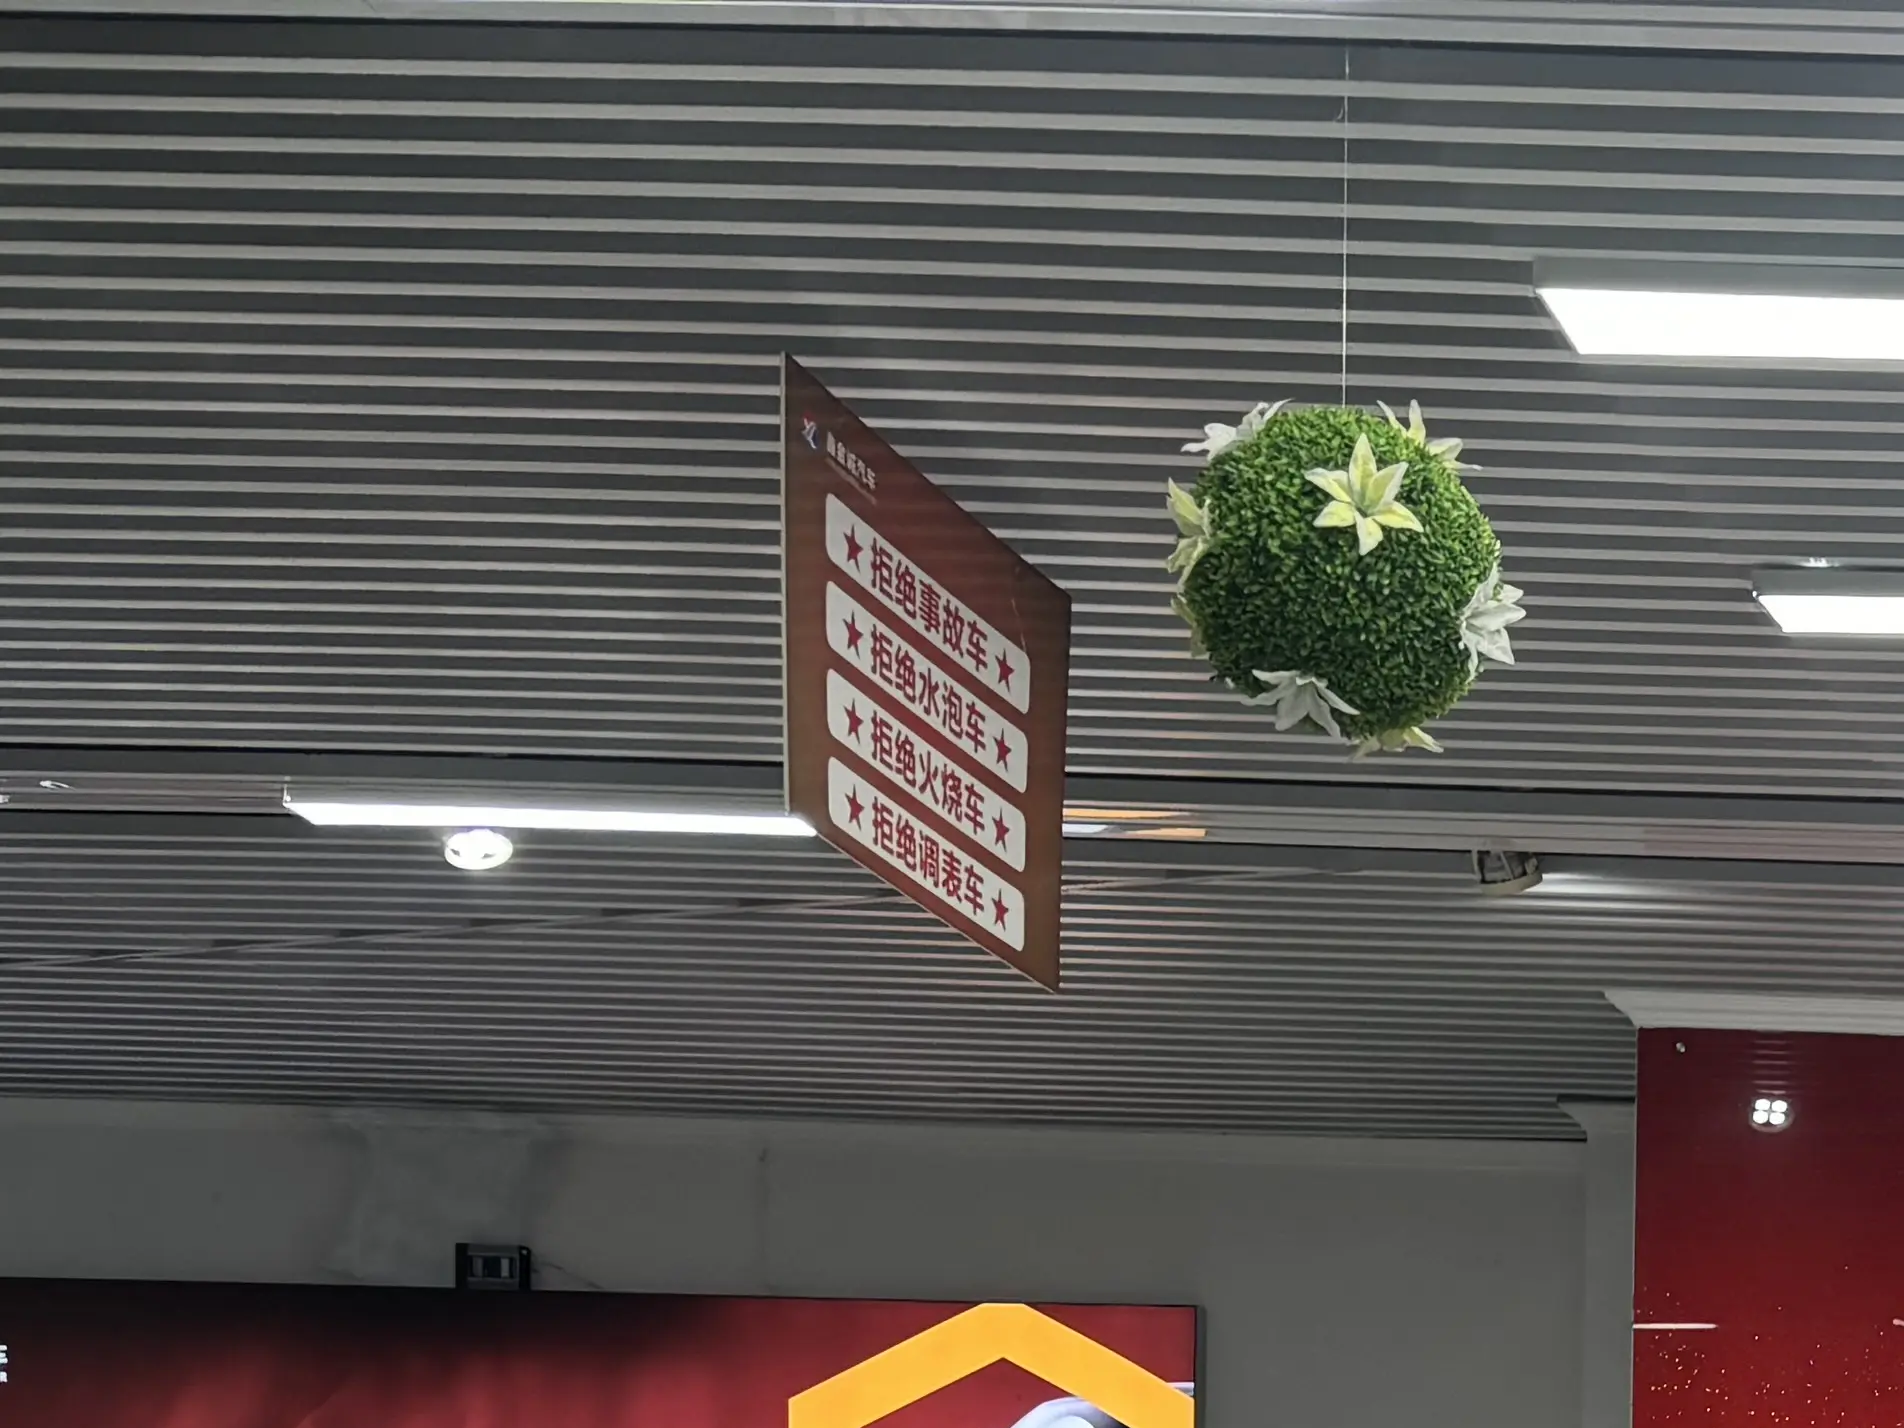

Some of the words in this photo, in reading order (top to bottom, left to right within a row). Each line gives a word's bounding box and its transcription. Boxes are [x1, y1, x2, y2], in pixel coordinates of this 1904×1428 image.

[871, 538, 987, 671] 拒绝事故车
[871, 624, 986, 754] 拒绝水泡车
[871, 711, 985, 835] 拒绝火烧车
[872, 796, 985, 915] 拒绝调表车
